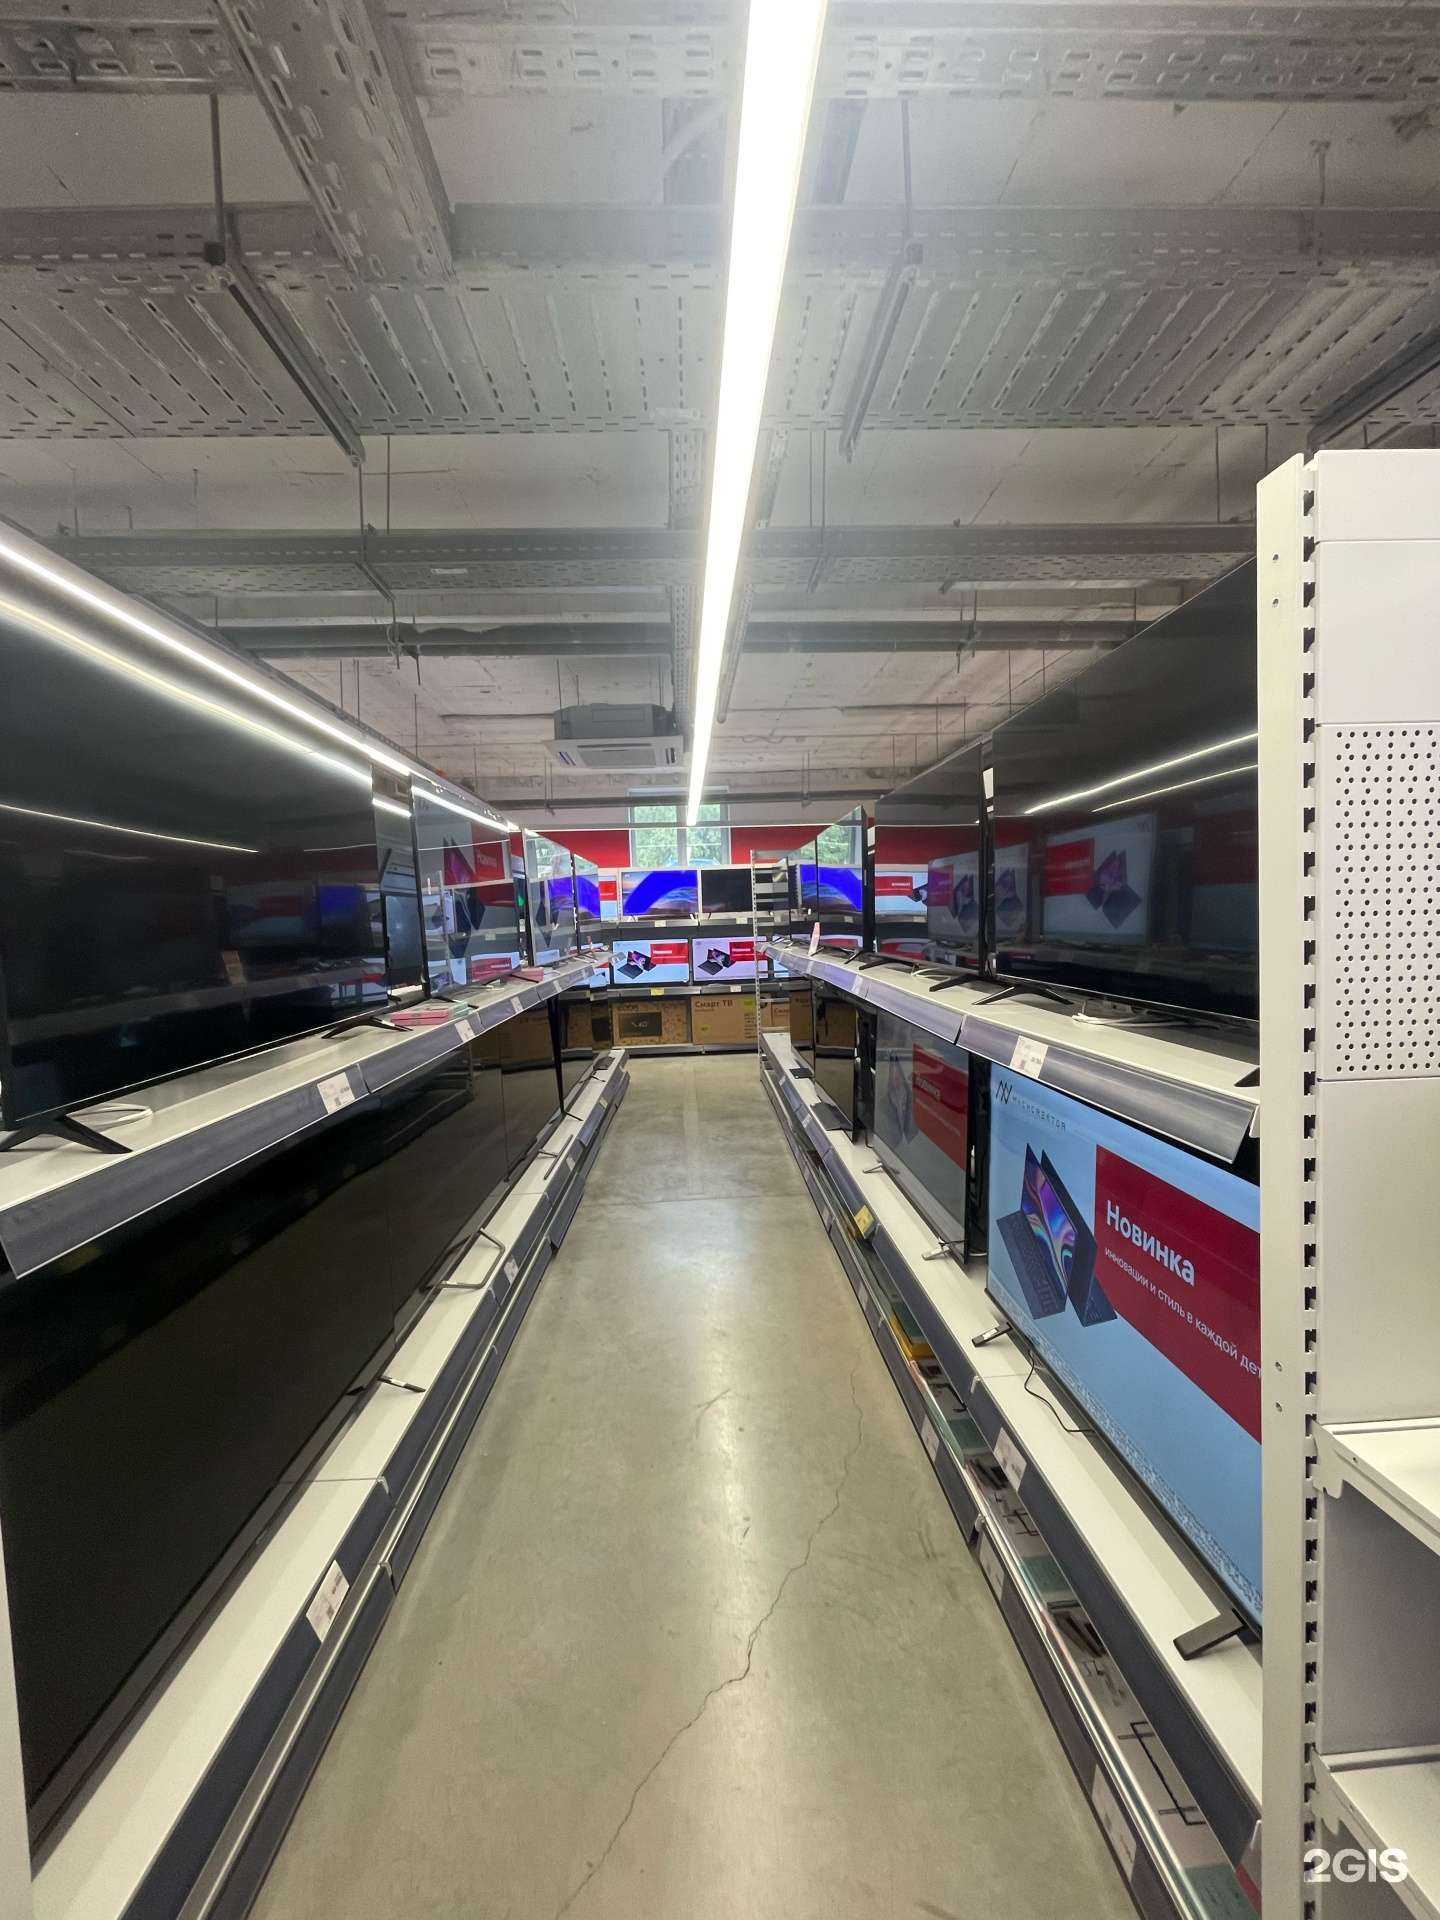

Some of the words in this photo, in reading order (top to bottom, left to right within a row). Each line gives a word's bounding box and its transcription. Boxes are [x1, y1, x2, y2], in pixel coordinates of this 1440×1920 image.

[1106, 1199, 1196, 1287] Новинка
[1104, 1247, 1150, 1290] инновации
[1149, 1283, 1157, 1296] и
[1157, 1288, 1186, 1318] стиль
[1186, 1311, 1194, 1324] в
[1195, 1318, 1239, 1359] каждой
